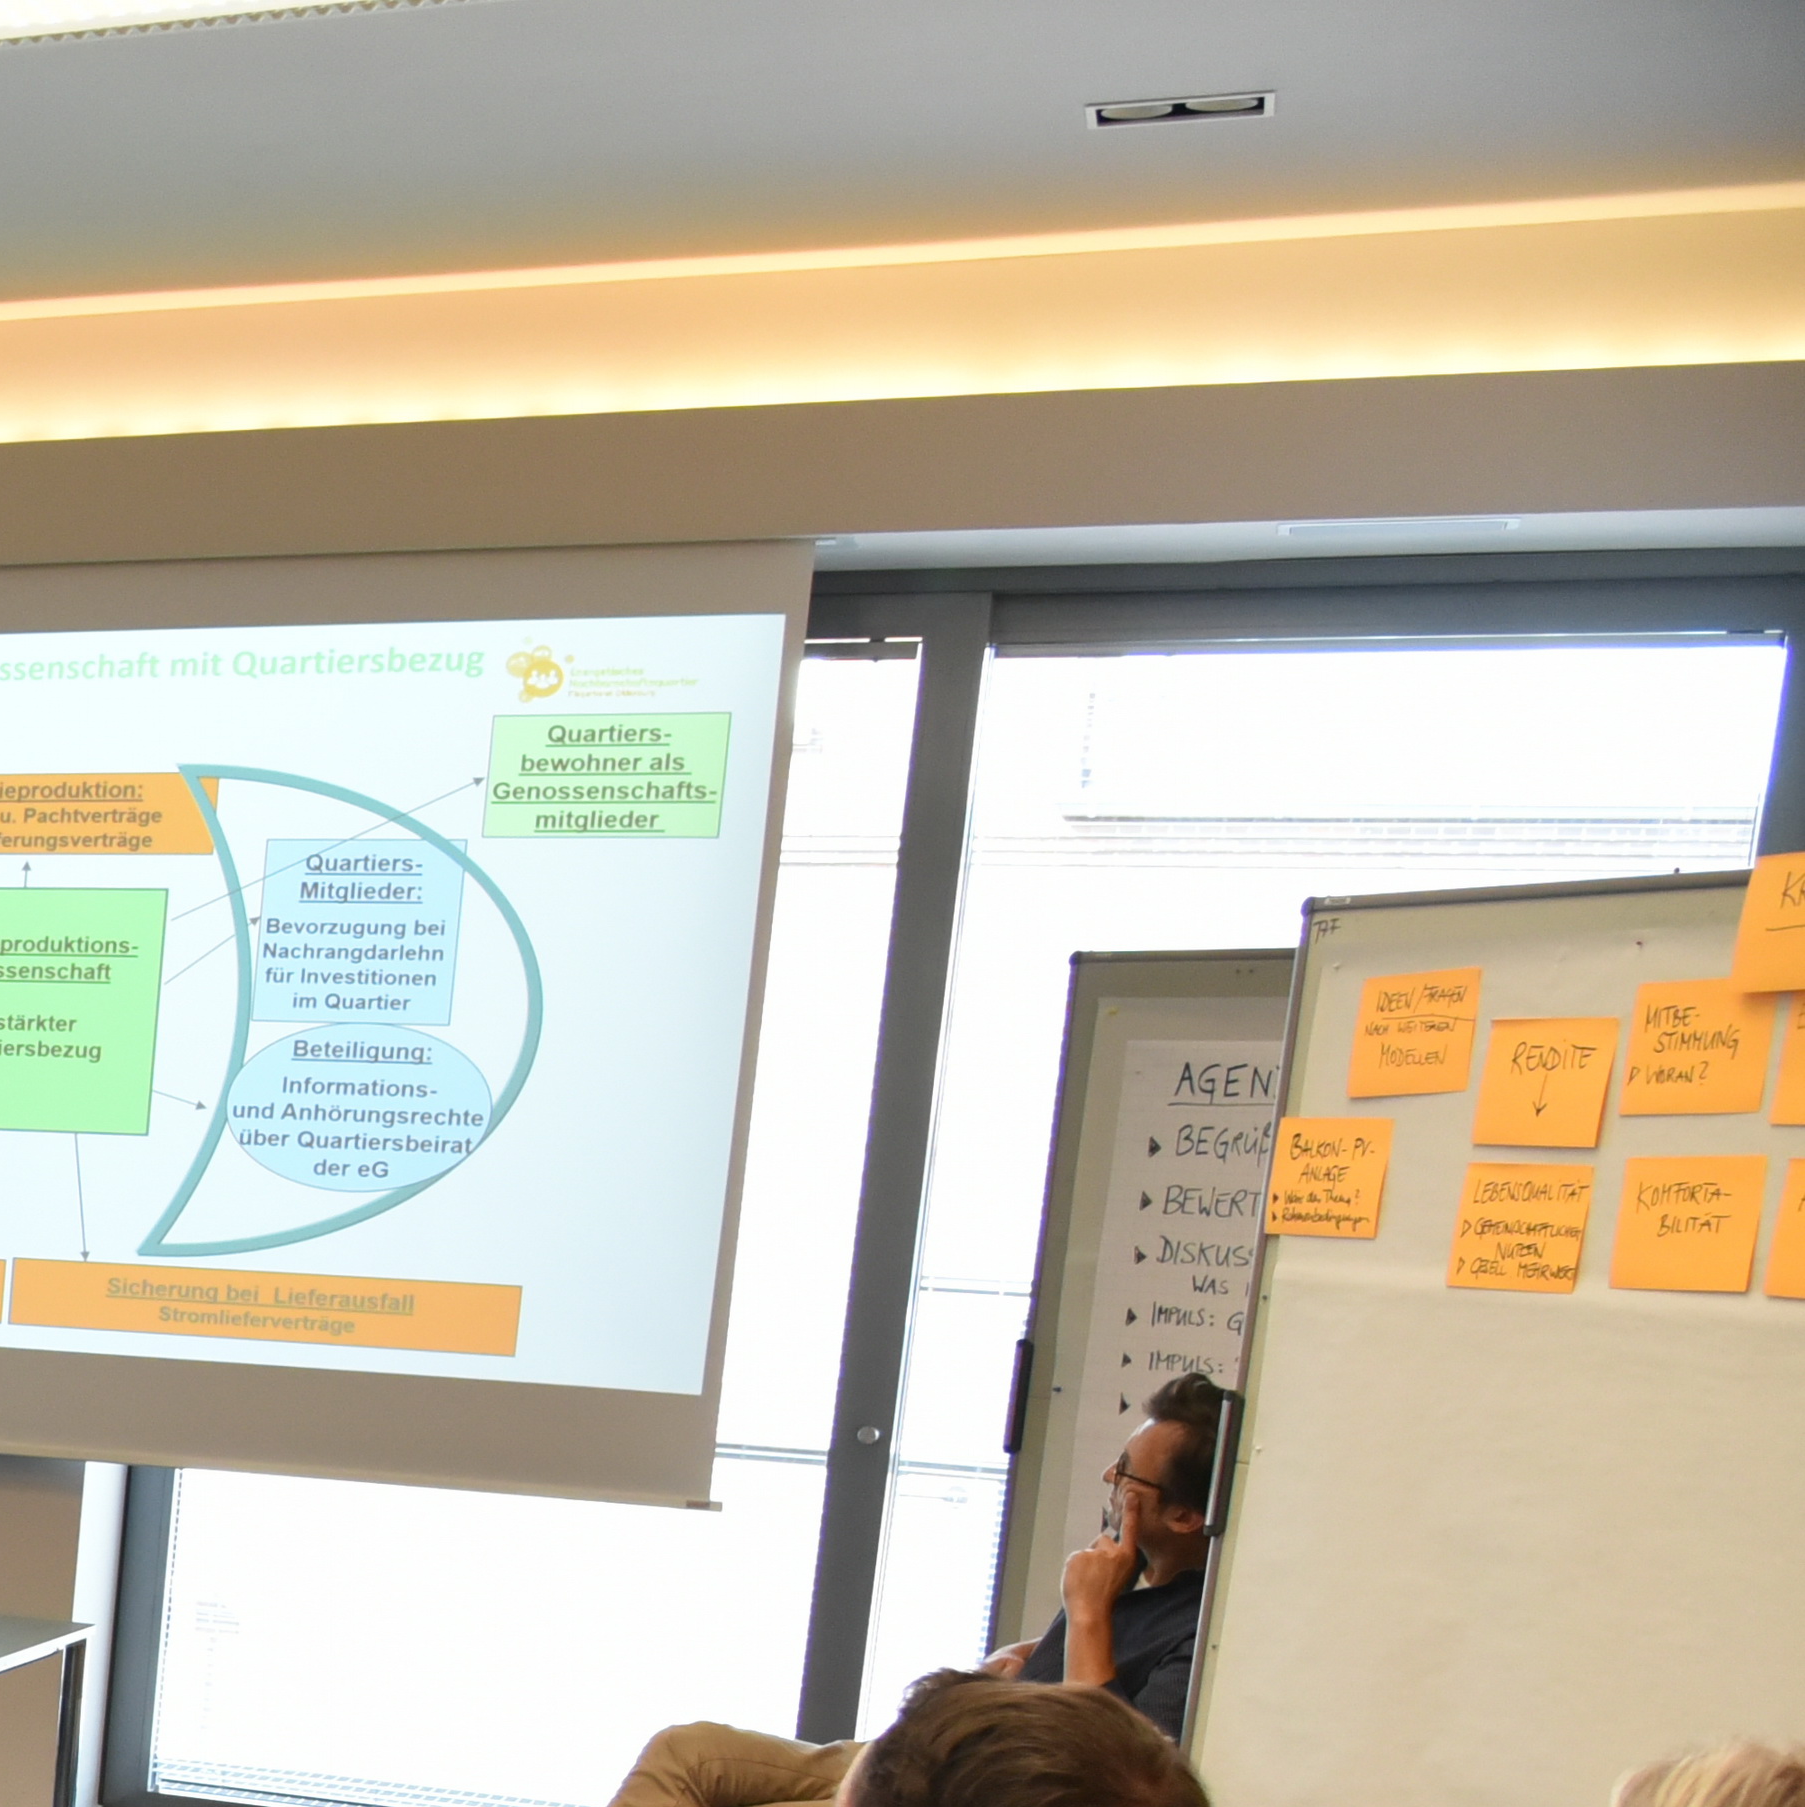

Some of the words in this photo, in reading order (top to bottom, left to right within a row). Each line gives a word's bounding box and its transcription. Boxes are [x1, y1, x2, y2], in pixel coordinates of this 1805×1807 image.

[170, 651, 222, 677] mit
[232, 646, 485, 679] Quartiersbezug
[547, 725, 672, 744] Quartiers-
[521, 754, 642, 773] bewohner
[649, 753, 685, 772] als
[492, 781, 717, 800] Genossenschafts-
[0, 813, 16, 824] u.
[24, 808, 162, 828] Pachtverträge
[535, 810, 659, 833] mitglieder
[305, 854, 423, 874] Quartiers-
[300, 882, 423, 903] Mitglieder:
[266, 918, 407, 939] Bevorzugung
[414, 920, 446, 936] bei
[263, 943, 445, 964] Nachrangdarlehn
[265, 968, 295, 984] für
[300, 968, 437, 987] Investitionen
[292, 992, 317, 1009] im
[325, 993, 411, 1011] Quartier
[1644, 1004, 1700, 1033] MITBE-
[293, 1039, 433, 1063] Beteiligung:
[1653, 1023, 1740, 1060] STIMMUNG
[1511, 1039, 1598, 1075] RENDITE
[282, 1076, 438, 1098] Informations-
[1174, 1061, 1275, 1104] AGEN
[233, 1102, 274, 1120] und
[281, 1103, 484, 1128] Anhörungsrechte
[239, 1130, 290, 1147] über
[298, 1131, 473, 1154] Quartiersbeirat
[313, 1159, 351, 1177] der
[358, 1161, 389, 1178] eG
[1297, 1162, 1351, 1191] ANLAGE
[1162, 1184, 1261, 1219] BEWERT
[1473, 1179, 1590, 1204] LEBENSQUALITÄT
[1636, 1181, 1732, 1214] KOMFORTA-
[1657, 1212, 1732, 1237] BILITÄT
[1156, 1235, 1250, 1267] DISKUS
[107, 1277, 219, 1303] Sicherung
[227, 1283, 260, 1302] bei
[274, 1286, 415, 1314] Lieferausfall
[1192, 1274, 1229, 1295] WAS
[158, 1306, 355, 1335] Stromlieferverträge
